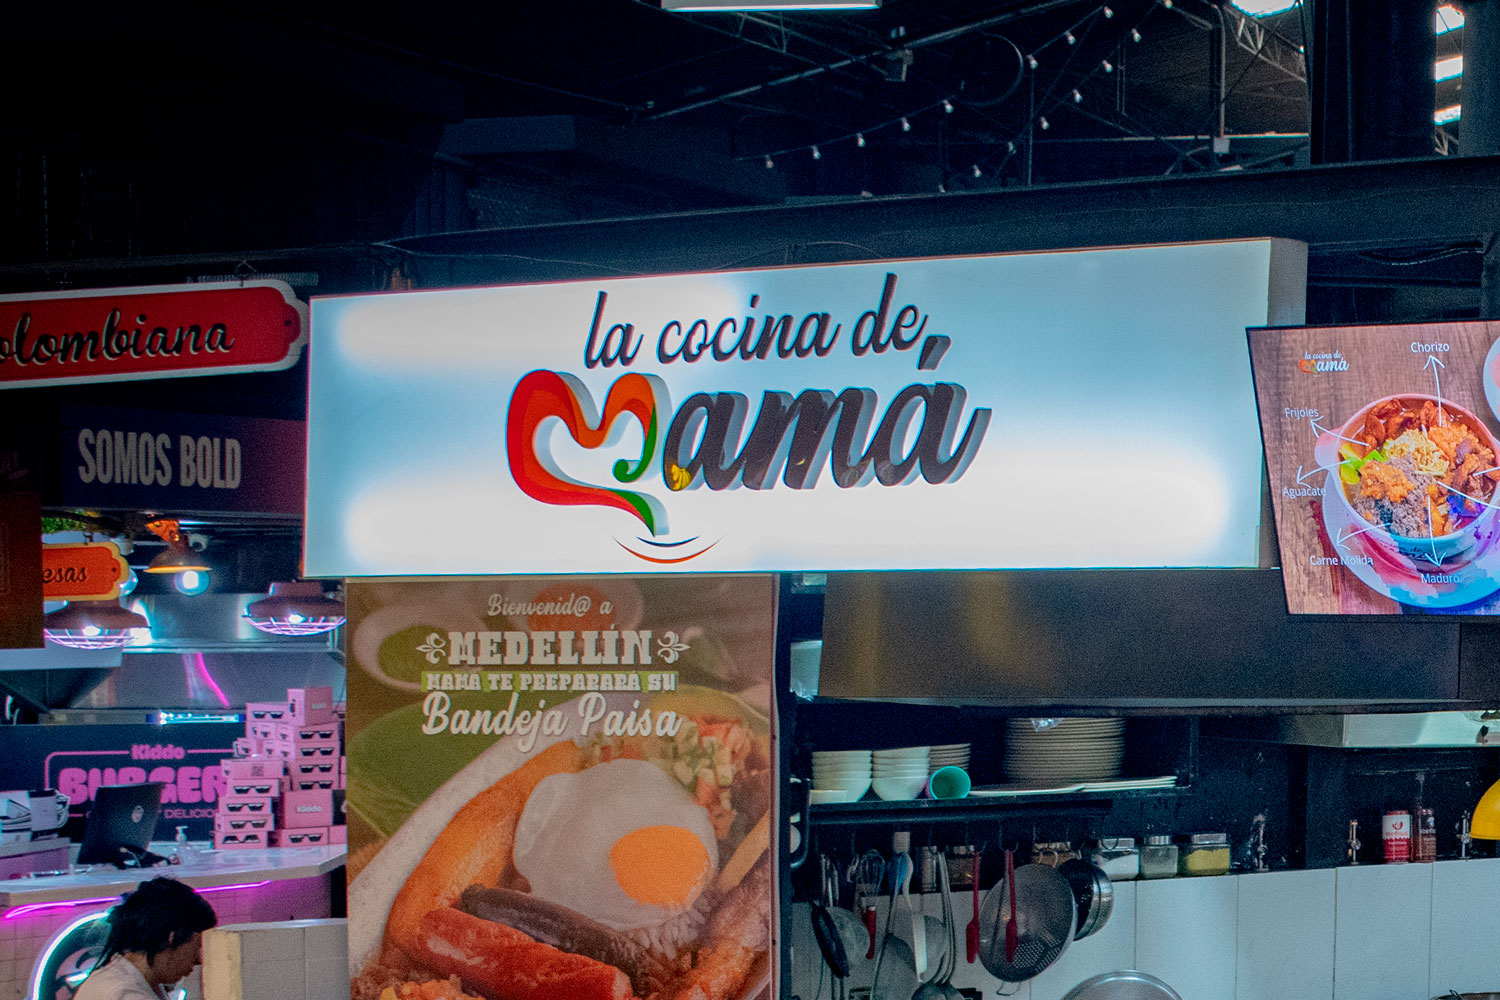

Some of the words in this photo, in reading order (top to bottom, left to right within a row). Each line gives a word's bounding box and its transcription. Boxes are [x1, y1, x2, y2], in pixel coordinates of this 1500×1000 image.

[583, 290, 645, 369] la
[656, 294, 843, 365] cocina
[850, 273, 930, 357] de
[1410, 341, 1450, 353] Chorizo
[1284, 407, 1320, 420] Frijoles
[78, 428, 173, 486] SOMOS
[179, 434, 242, 489] BOLD
[1283, 487, 1327, 499] Aguacate
[1310, 555, 1339, 566] Carne
[1341, 555, 1374, 566] Molida
[1421, 573, 1460, 584] Maduro
[487, 593, 592, 617] Bienvenid@
[599, 600, 614, 616] a
[448, 624, 653, 666] MEDELLÍN
[487, 672, 514, 691] TE
[647, 672, 676, 691] SU
[422, 691, 569, 752] Bandeja
[578, 691, 683, 737] Paisa
[164, 808, 218, 819] DELICIO
